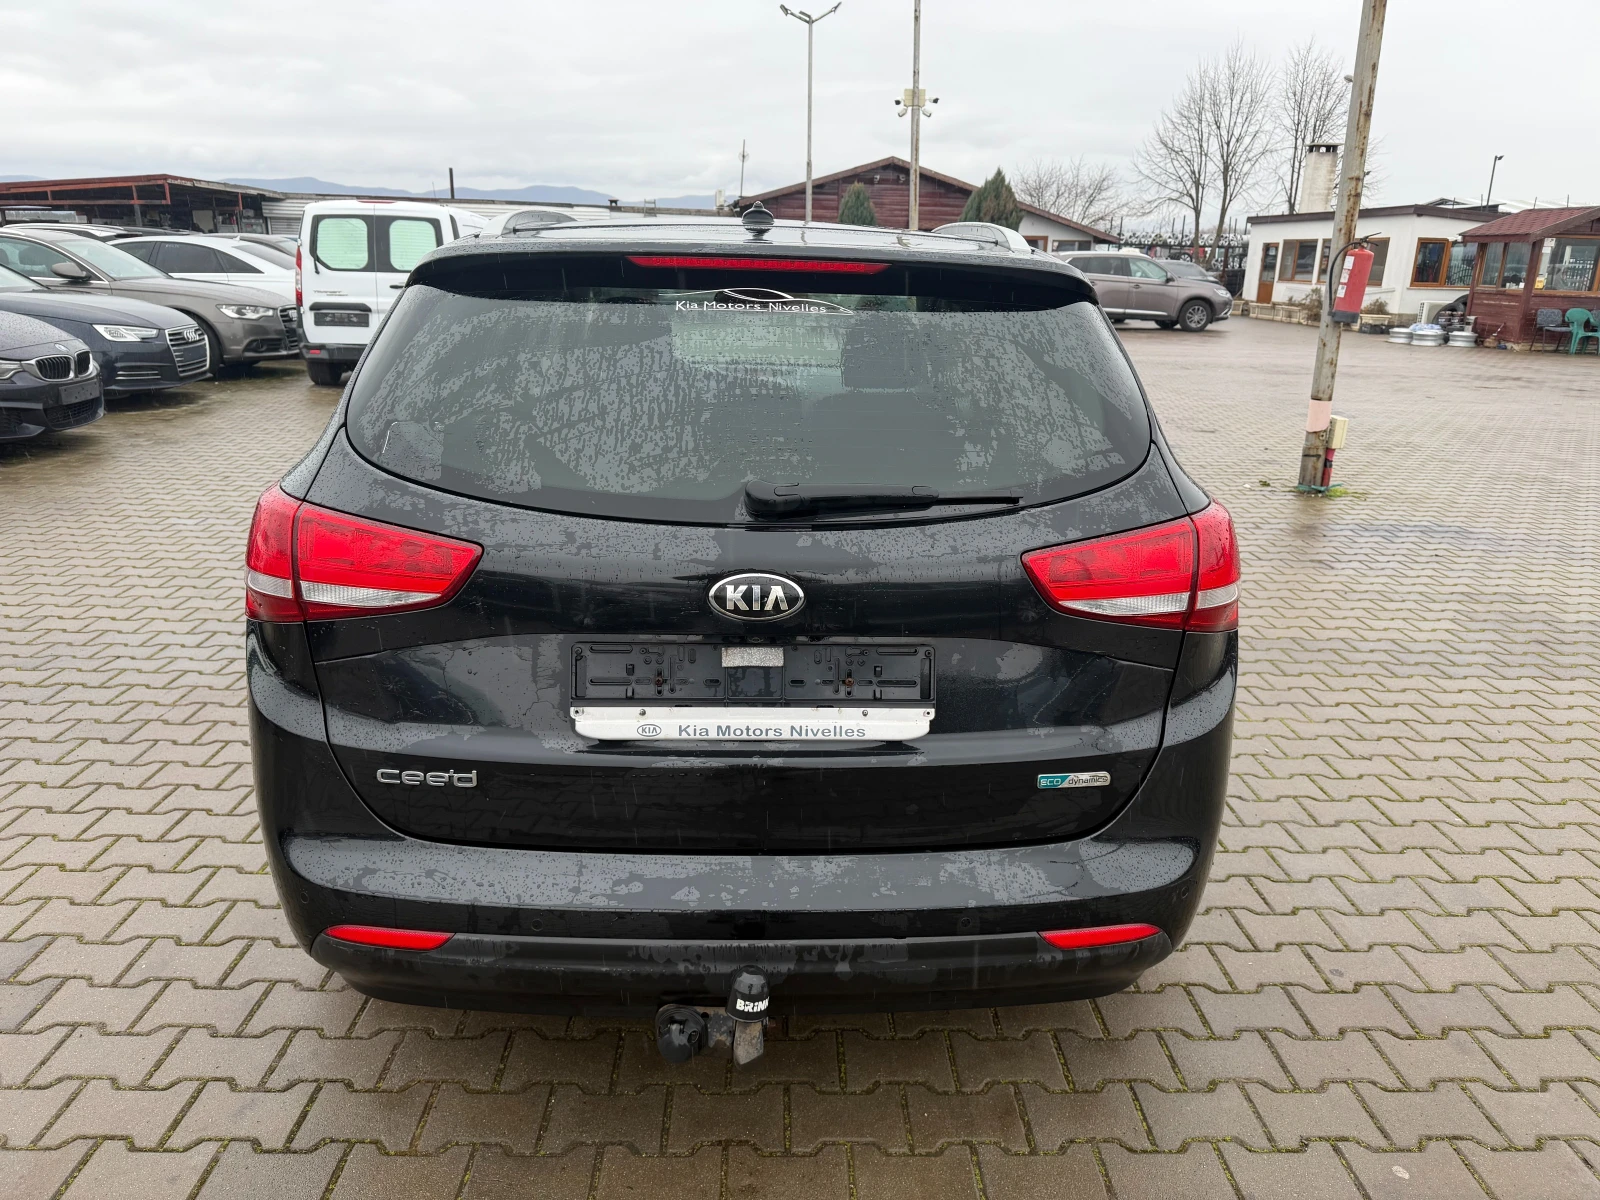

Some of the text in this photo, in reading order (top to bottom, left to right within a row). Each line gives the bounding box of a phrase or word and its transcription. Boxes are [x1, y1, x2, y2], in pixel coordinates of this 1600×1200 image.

[675, 300, 827, 314] Kia Motors Nivelles
[725, 584, 789, 611] KIA
[641, 724, 866, 738] KIA Kia Motors Nivelles
